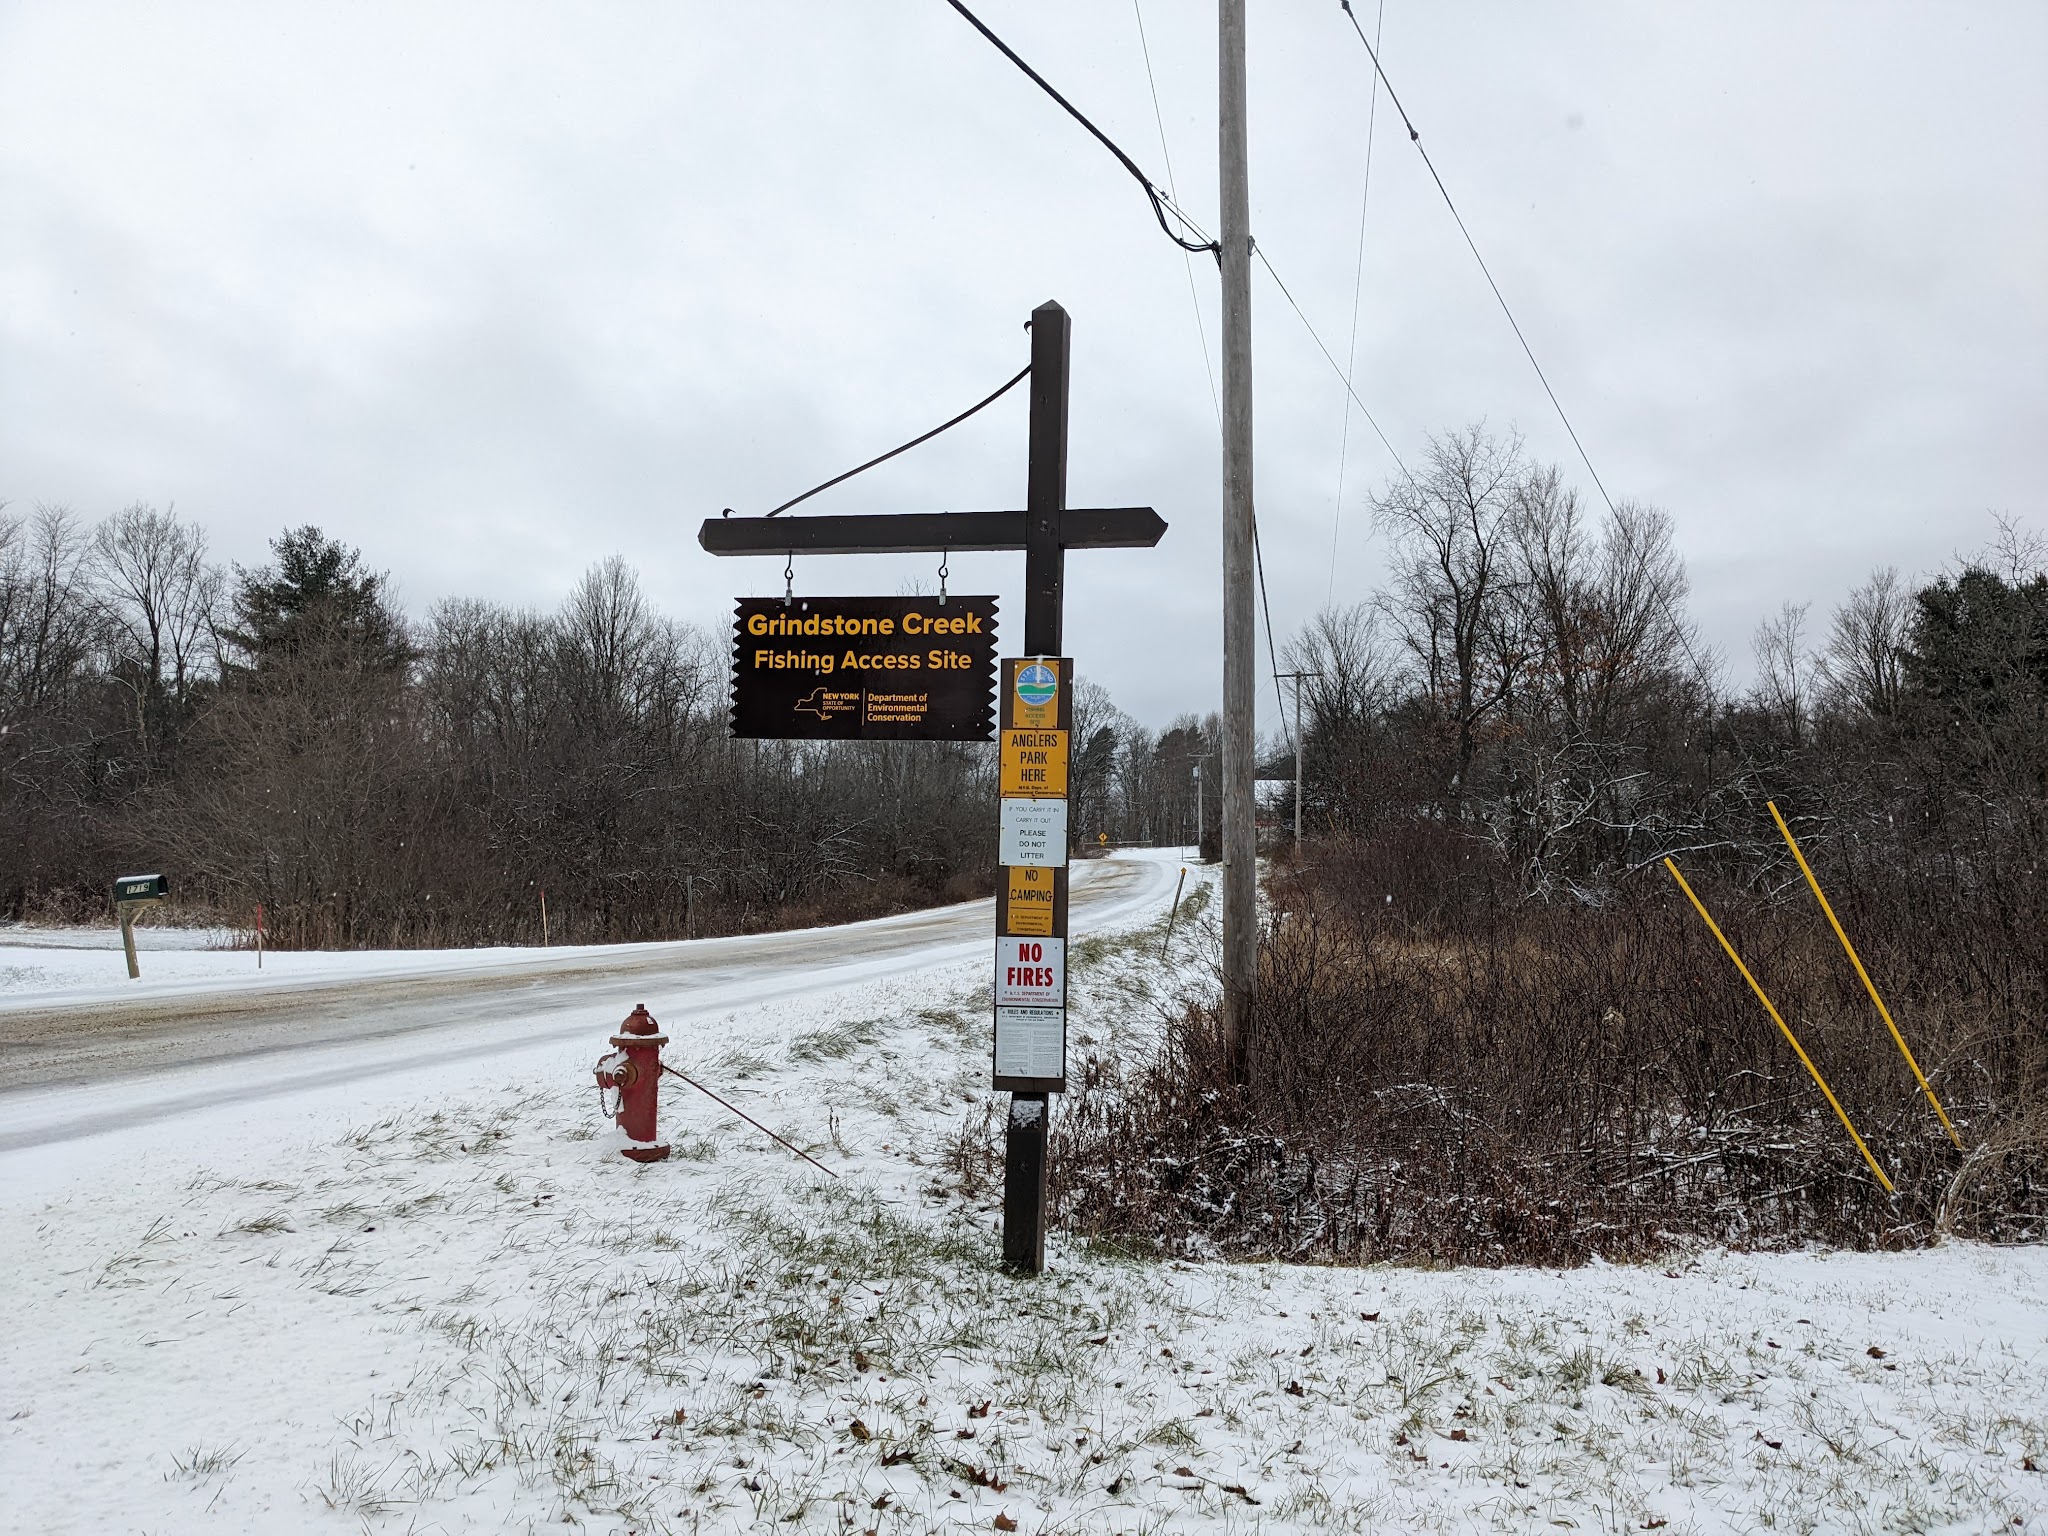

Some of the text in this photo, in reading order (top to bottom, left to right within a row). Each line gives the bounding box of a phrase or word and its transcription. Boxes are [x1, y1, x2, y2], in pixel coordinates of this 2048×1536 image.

[748, 612, 983, 636] Grindstone Creek
[755, 650, 972, 674] Fishing Access Site
[868, 693, 928, 704] Department of
[868, 704, 928, 712] Environmental
[868, 713, 922, 722] Conservation
[1012, 734, 1057, 747] ANGLERS
[1020, 752, 1048, 764] PARK
[1021, 768, 1046, 782] HERE
[1025, 870, 1038, 881] NO
[129, 884, 149, 893] 1719
[1010, 889, 1052, 902] CAMPING
[1019, 943, 1042, 962] NO
[1008, 967, 1053, 986] FIRES
